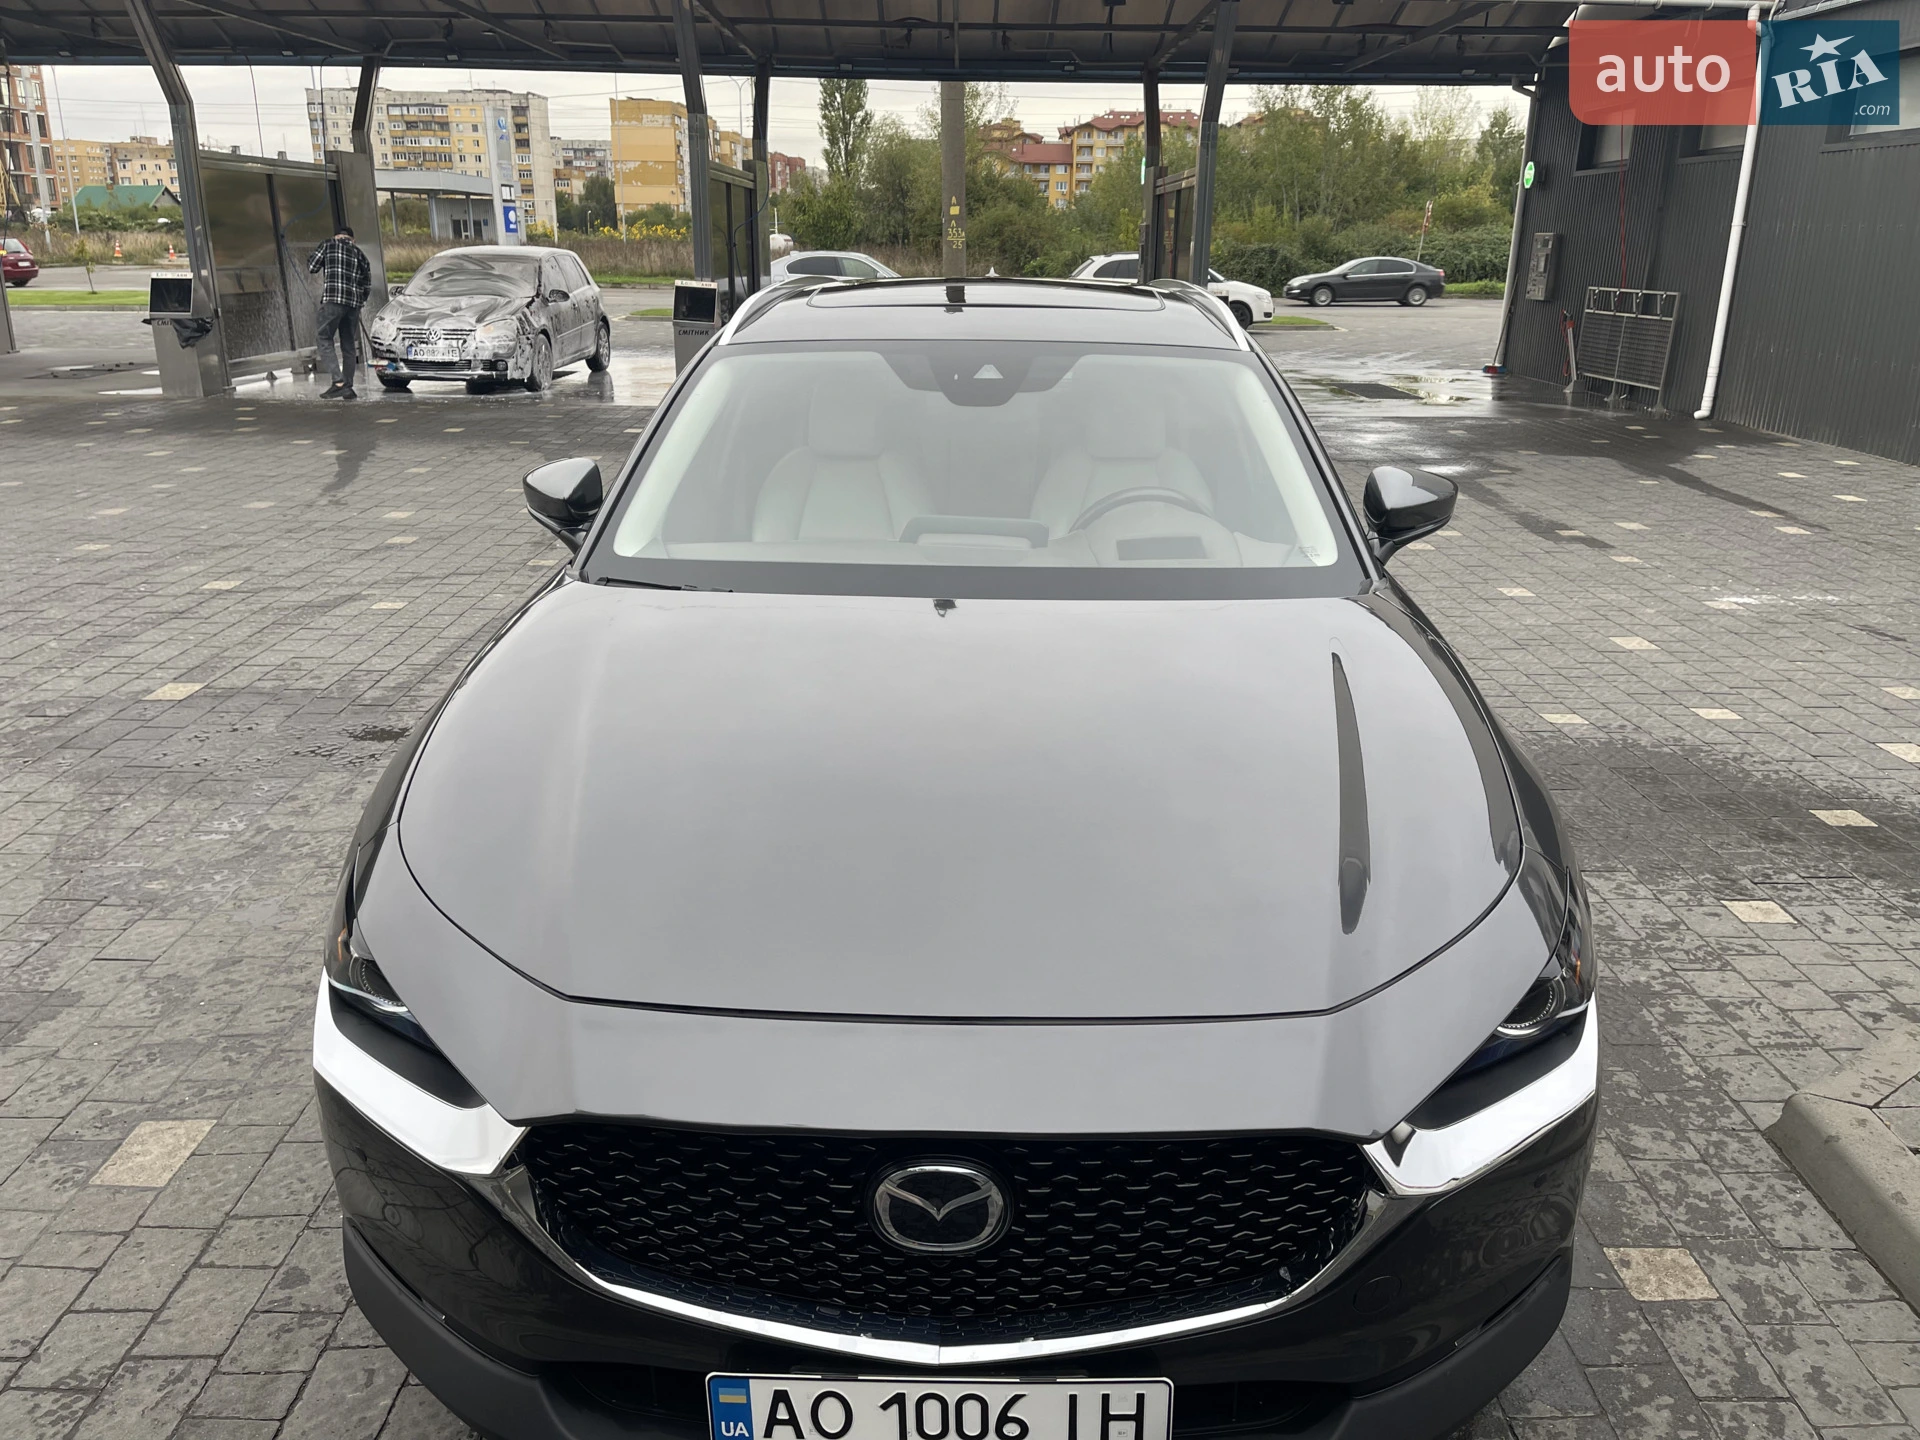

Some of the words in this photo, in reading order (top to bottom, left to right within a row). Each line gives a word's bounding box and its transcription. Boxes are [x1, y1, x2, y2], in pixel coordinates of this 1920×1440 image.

[952, 240, 963, 249] 25
[763, 1389, 854, 1440] AO
[879, 1392, 1030, 1440] 1006
[1067, 1392, 1145, 1440] IH
[720, 1421, 750, 1438] UA
